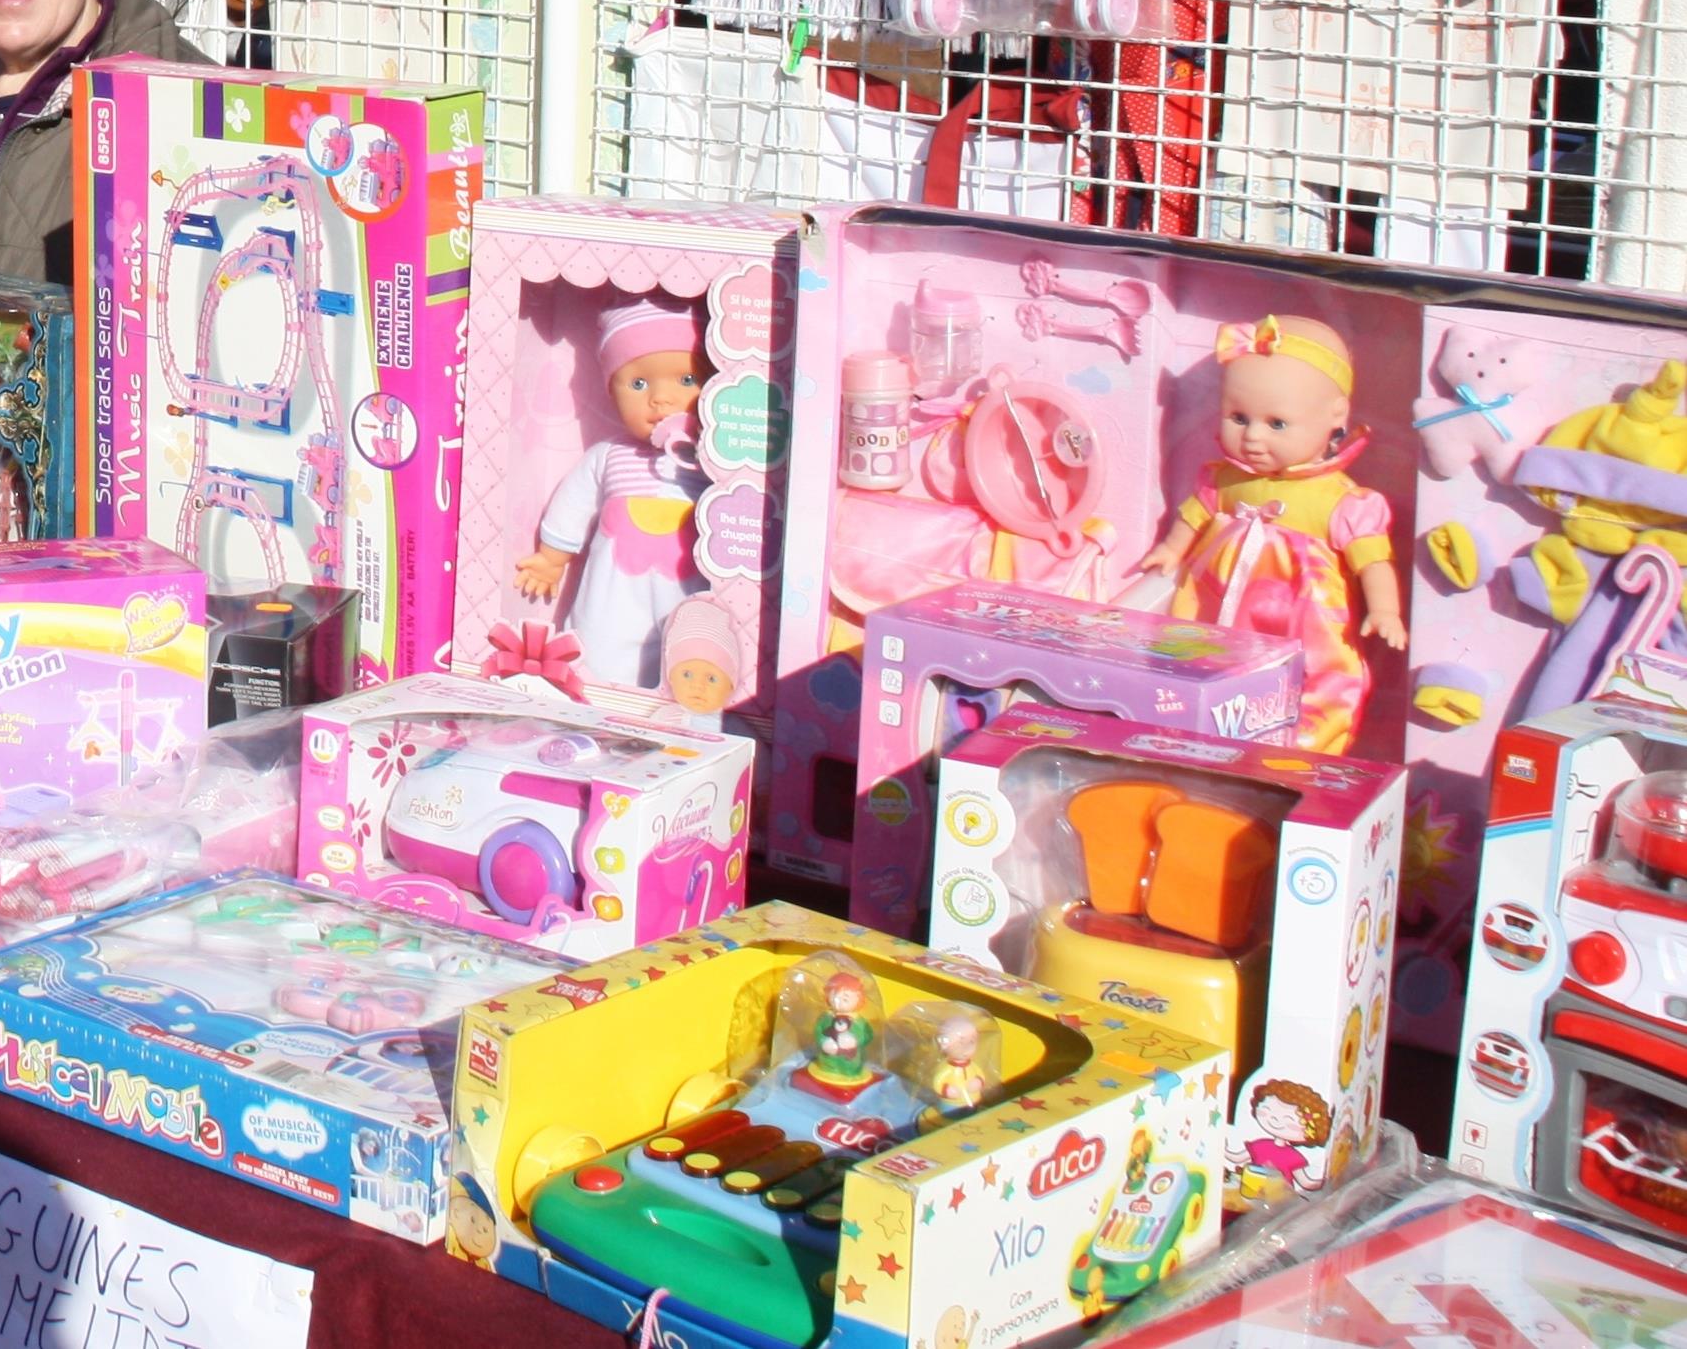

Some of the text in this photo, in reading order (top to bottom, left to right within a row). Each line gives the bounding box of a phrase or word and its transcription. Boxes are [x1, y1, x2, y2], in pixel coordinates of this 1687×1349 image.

[96, 107, 110, 165] 85PCS
[376, 281, 392, 367] EXTREME
[395, 264, 412, 369] CHALLENGE
[95, 286, 114, 505] Super track series
[116, 220, 144, 527] Music Train
[406, 529, 416, 580] BATTERY
[1154, 701, 1186, 713] YEARS
[1155, 687, 1177, 702] 3+
[409, 797, 455, 822] Fashion
[925, 956, 1011, 991] ruca
[104, 1068, 225, 1159] Mobile
[249, 1114, 321, 1134] OF MUSICAL
[253, 1127, 320, 1146] MOVEMENT
[1038, 1142, 1098, 1191] ruca
[989, 1217, 1046, 1277] Xilo
[0, 1272, 204, 1349] MEIT
